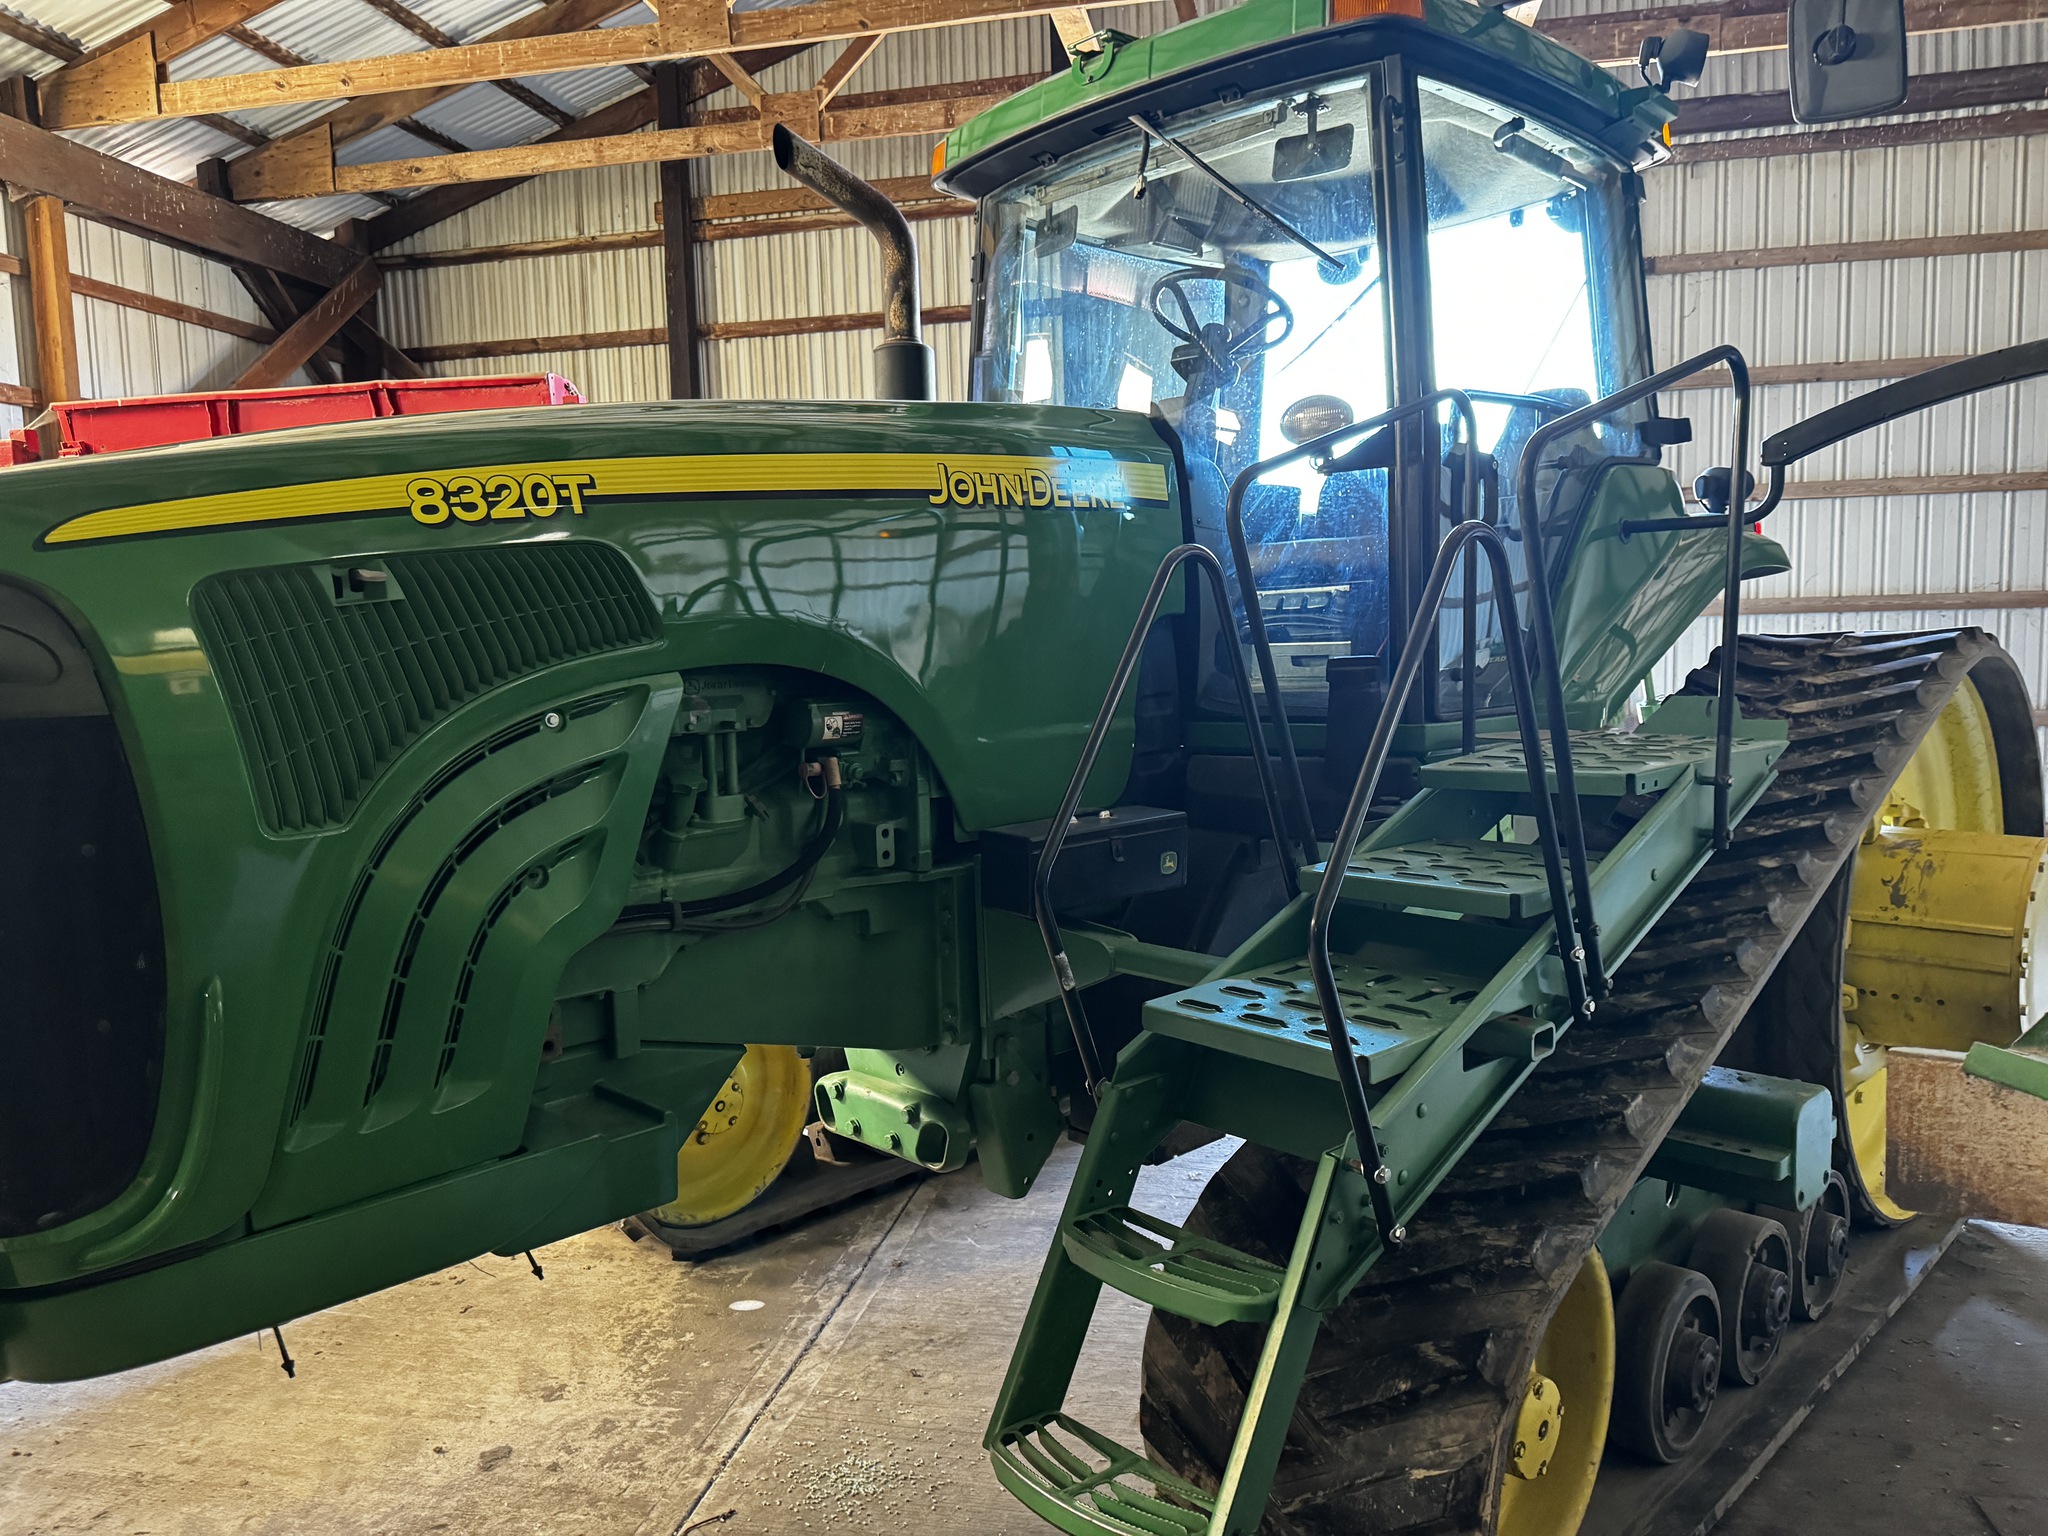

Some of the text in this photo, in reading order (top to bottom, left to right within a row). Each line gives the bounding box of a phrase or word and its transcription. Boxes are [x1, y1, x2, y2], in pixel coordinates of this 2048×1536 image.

[406, 472, 597, 527] 8320T
[929, 463, 1125, 510] JOHN DEERE
